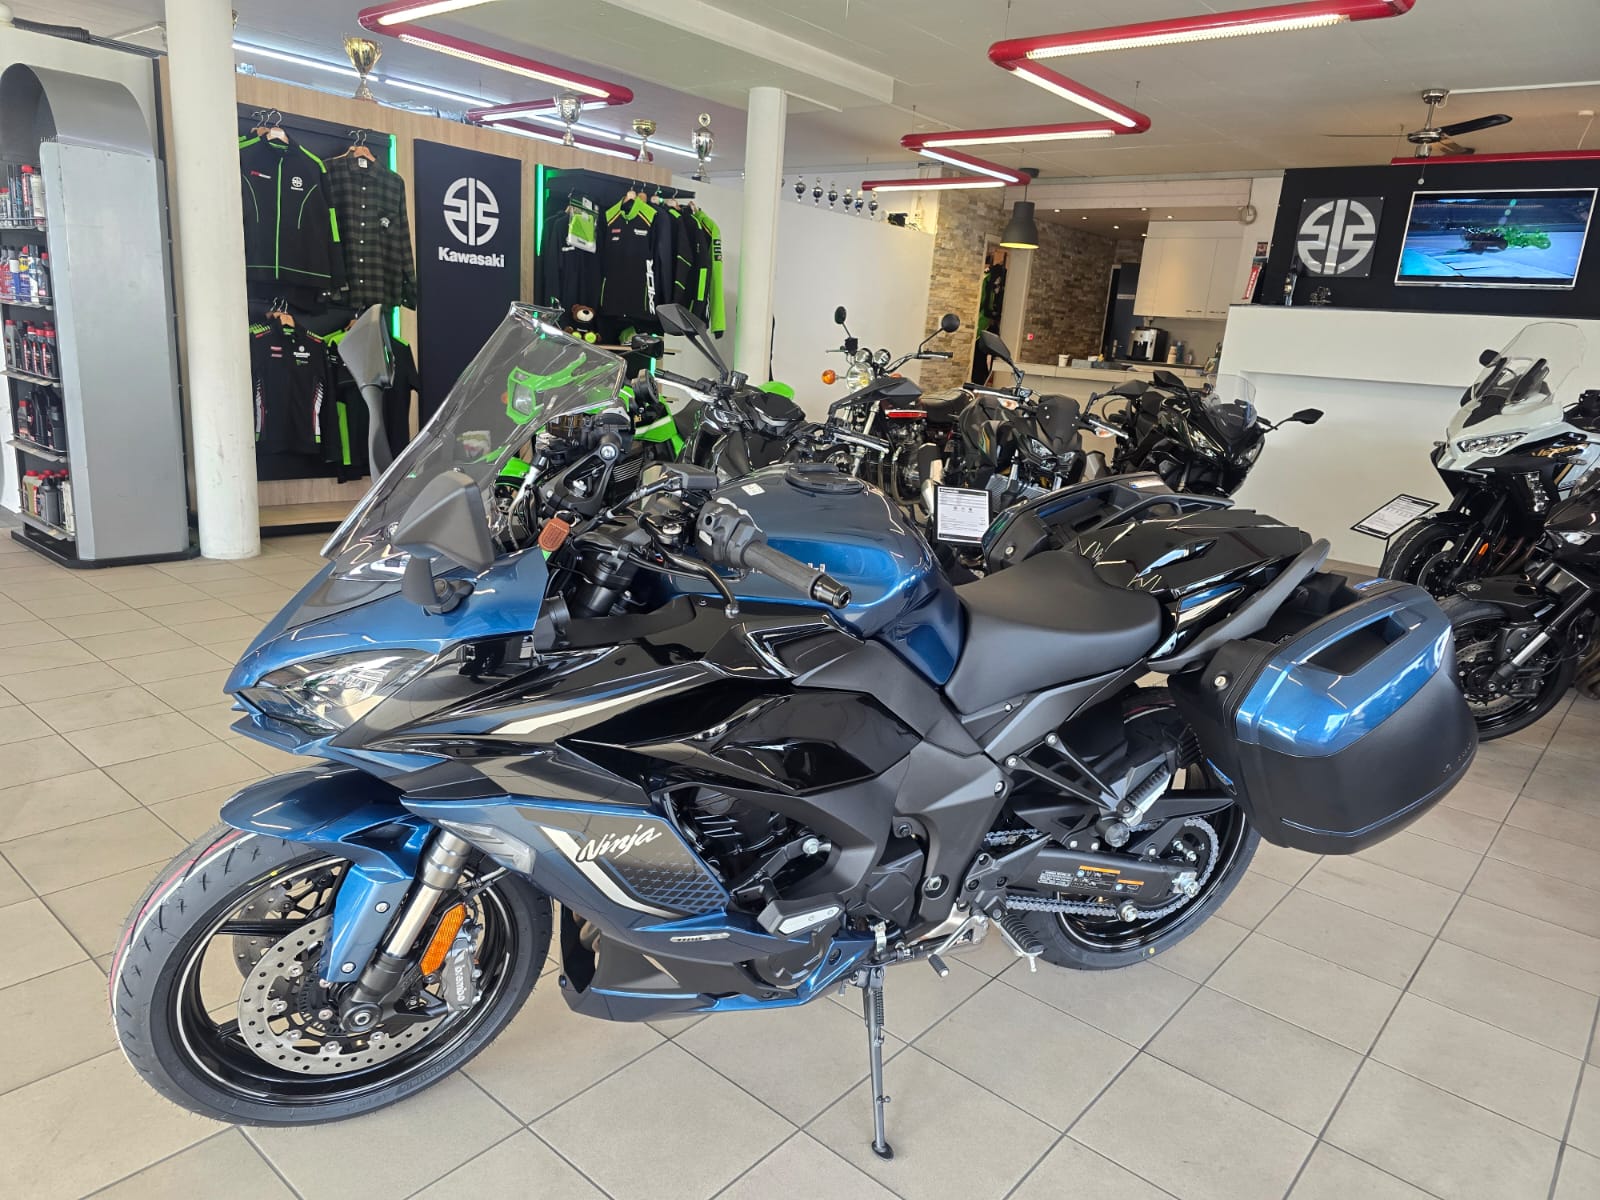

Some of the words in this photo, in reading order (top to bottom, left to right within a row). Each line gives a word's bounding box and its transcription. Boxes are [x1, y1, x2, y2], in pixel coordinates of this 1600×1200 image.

[438, 246, 505, 268] Kawasaki
[576, 823, 662, 860] Ninja
[454, 964, 467, 1002] brembo
